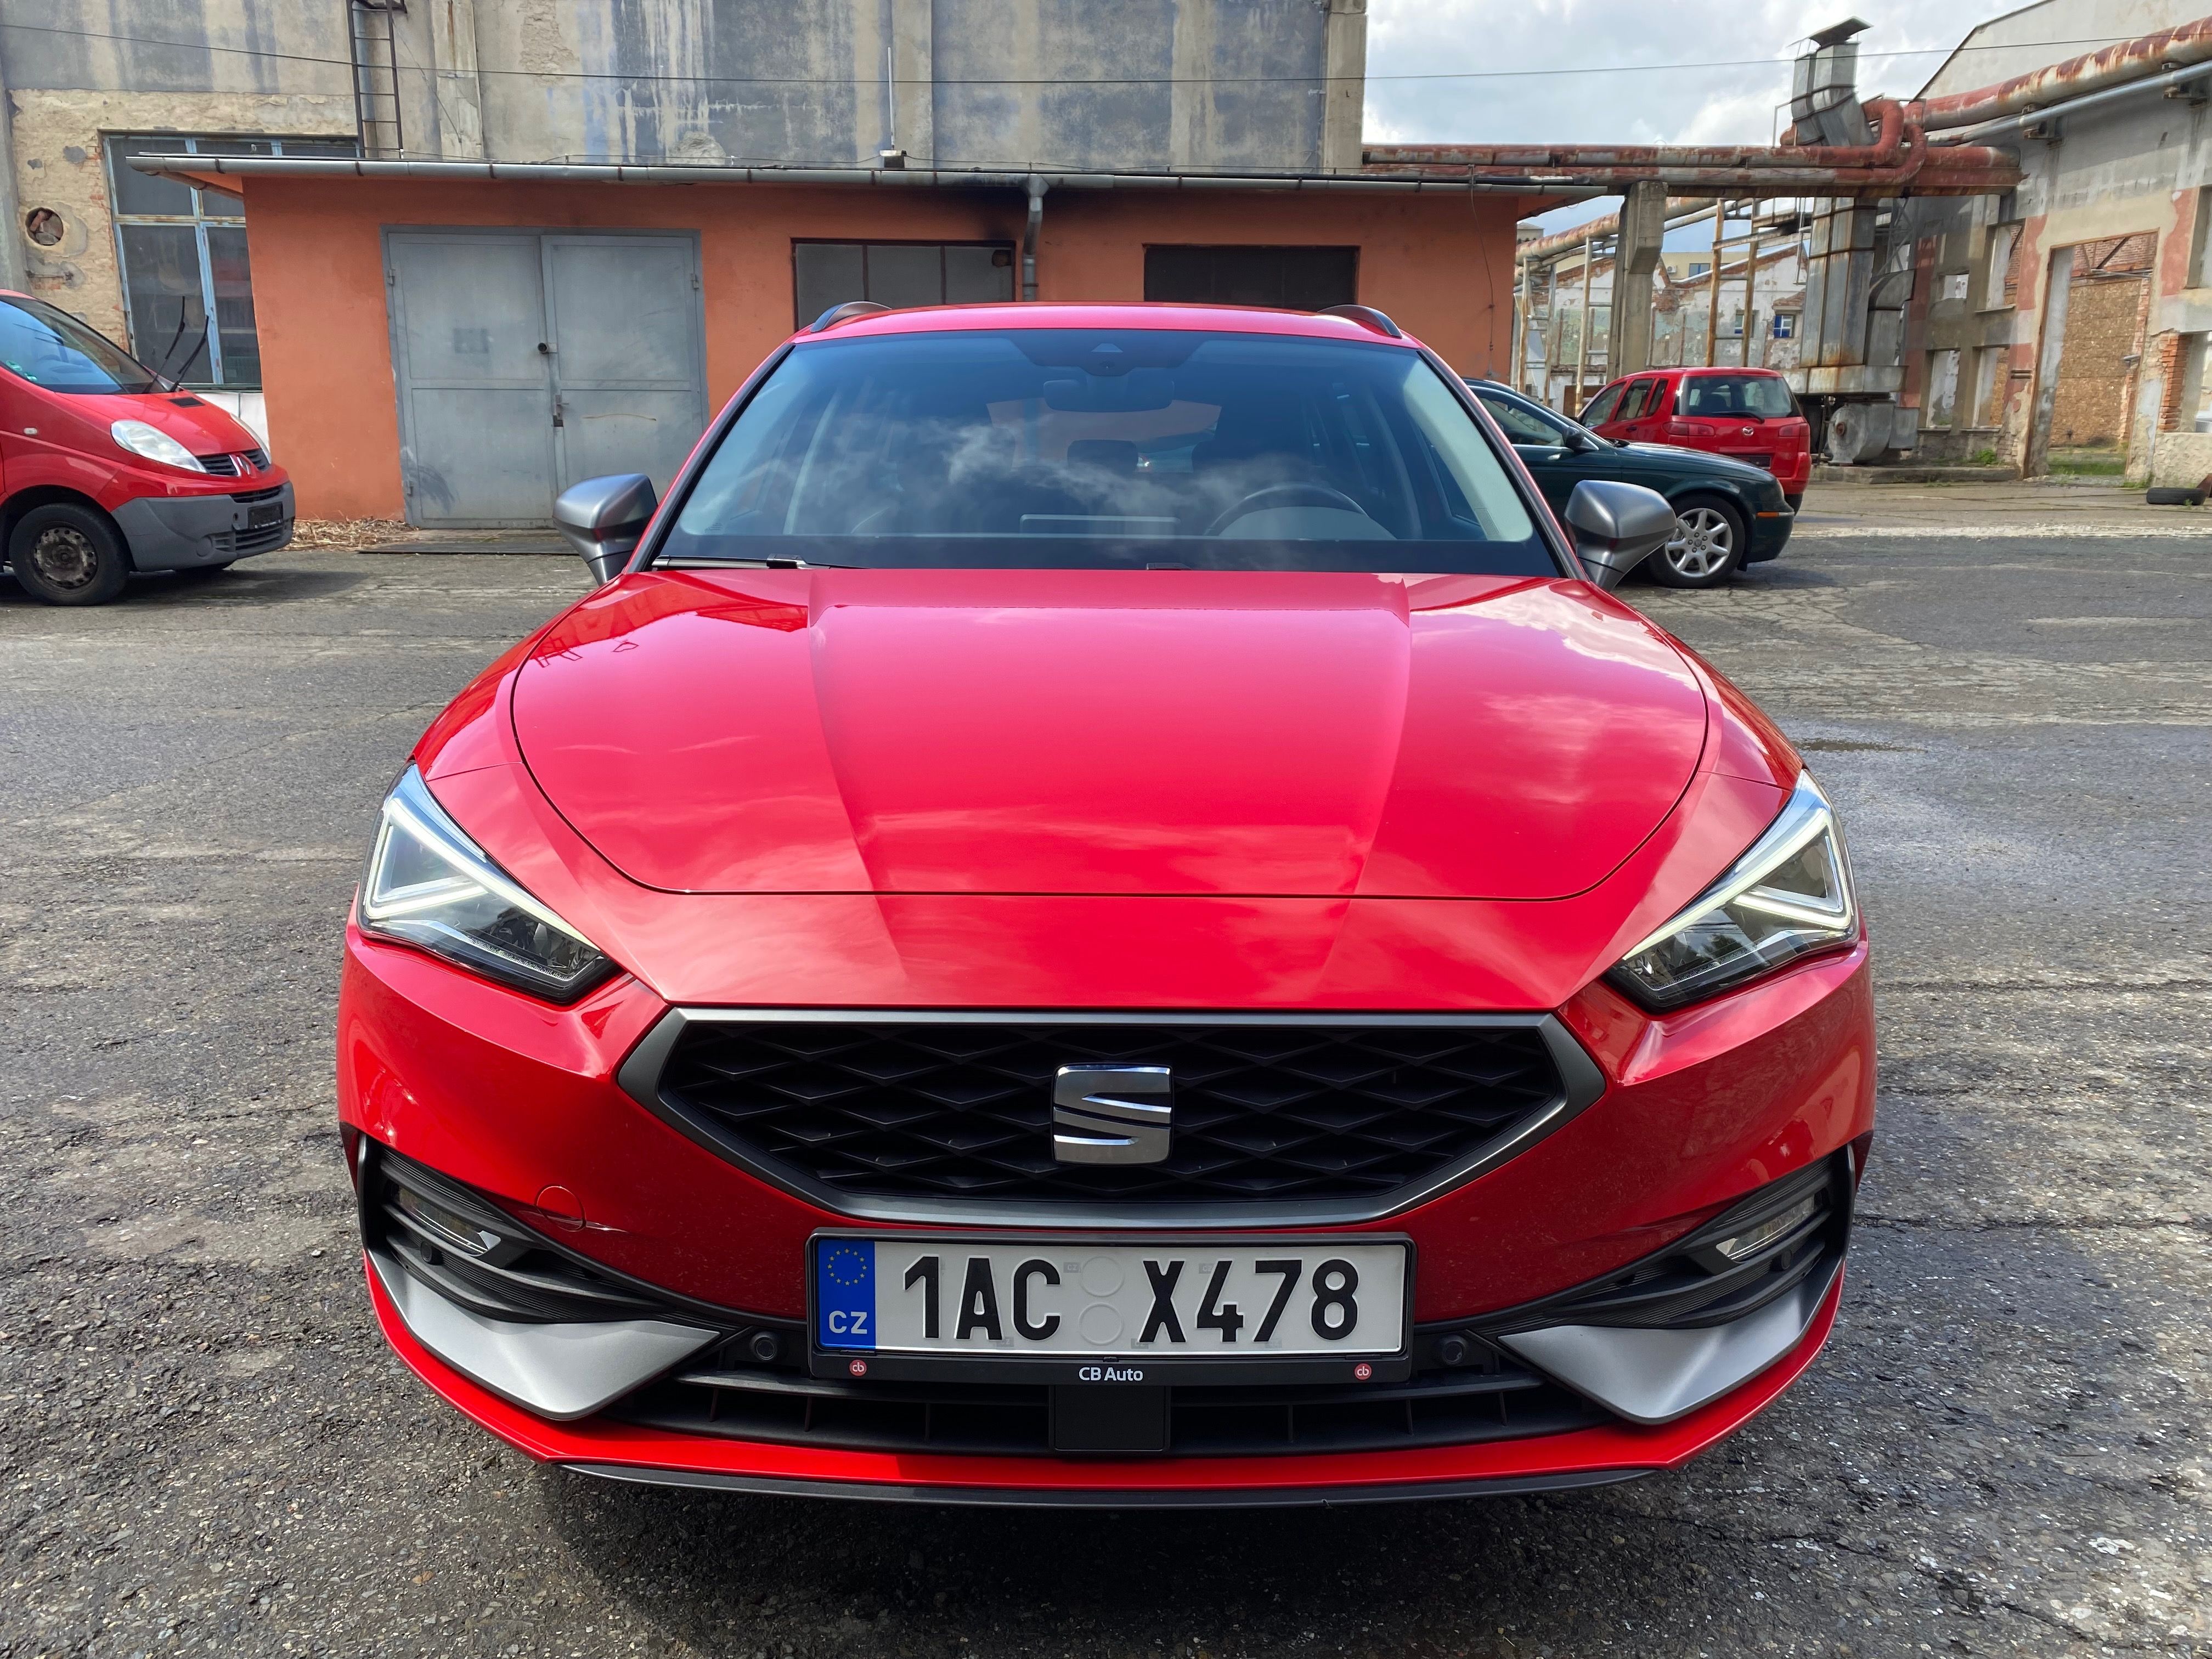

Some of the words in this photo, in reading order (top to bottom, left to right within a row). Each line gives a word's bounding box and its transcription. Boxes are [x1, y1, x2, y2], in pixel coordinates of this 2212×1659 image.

[829, 1310, 867, 1334] CZ
[905, 1256, 1061, 1341] 1AC
[1139, 1259, 1359, 1343] X478
[852, 1362, 865, 1372] cb
[1357, 1365, 1369, 1376] cb
[1079, 1367, 1101, 1381] CB
[1104, 1367, 1143, 1381] Auto
